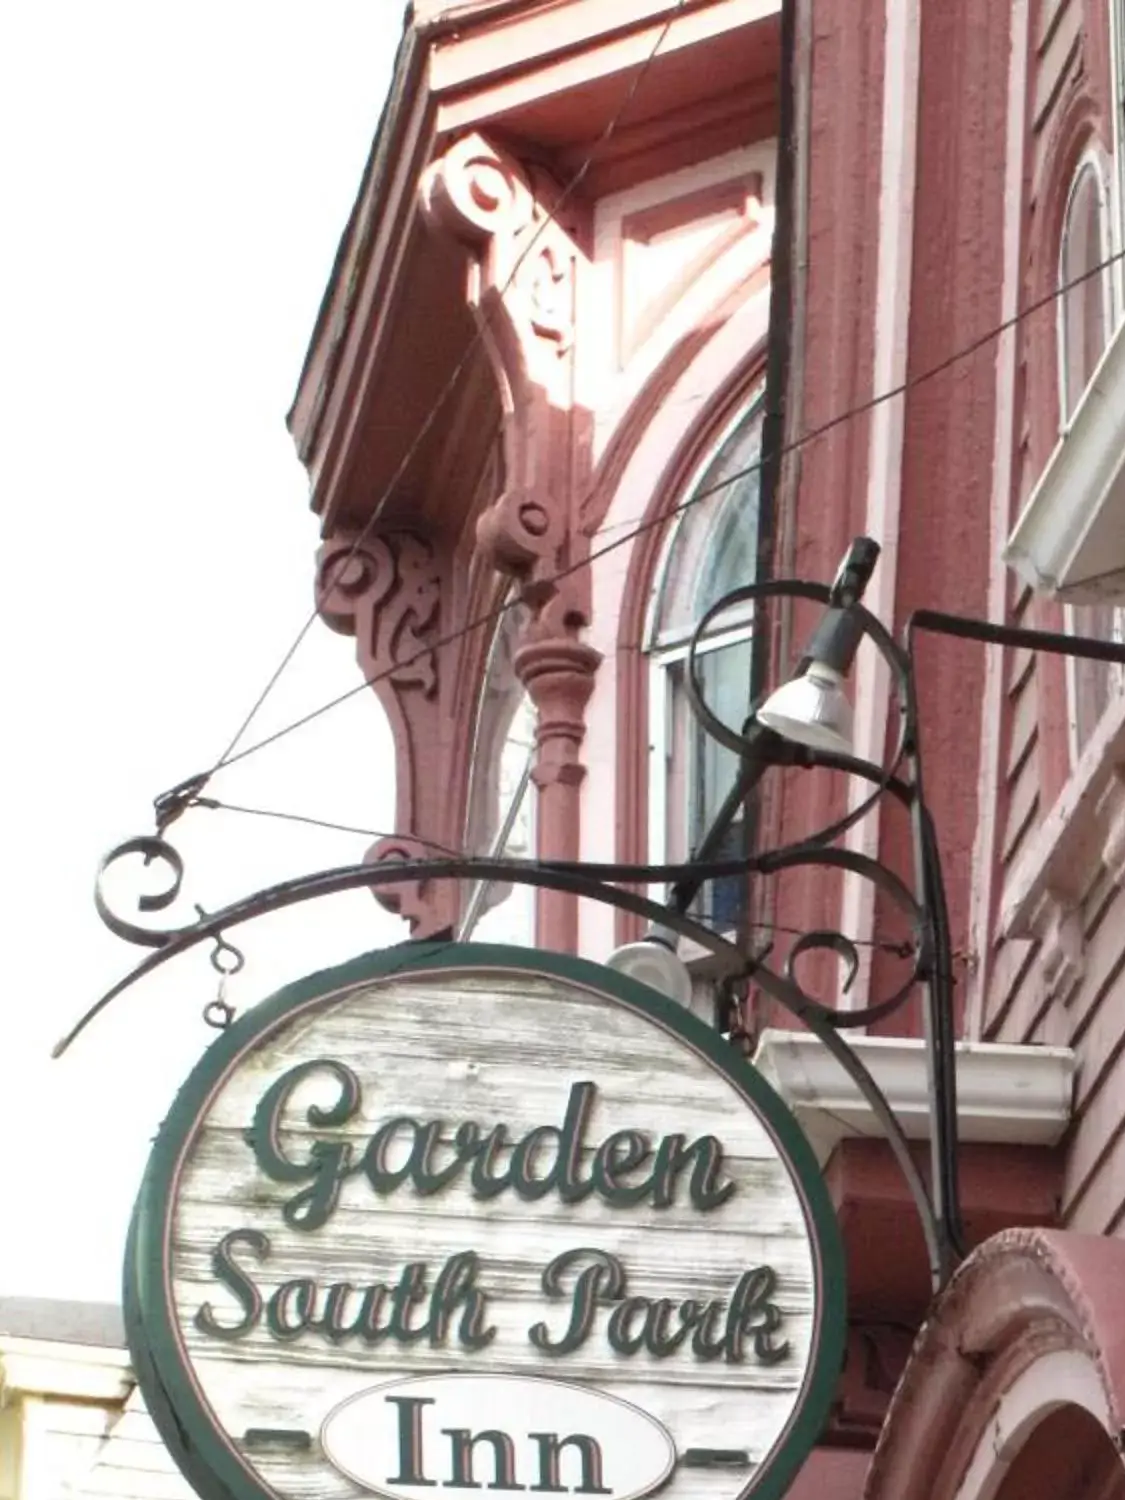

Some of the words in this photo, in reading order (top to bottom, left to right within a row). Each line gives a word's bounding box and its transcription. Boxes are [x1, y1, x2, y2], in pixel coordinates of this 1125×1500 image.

[250, 1060, 736, 1230] Garden
[197, 1230, 496, 1351] South
[529, 1248, 790, 1364] Park
[385, 1396, 613, 1495] Inn
